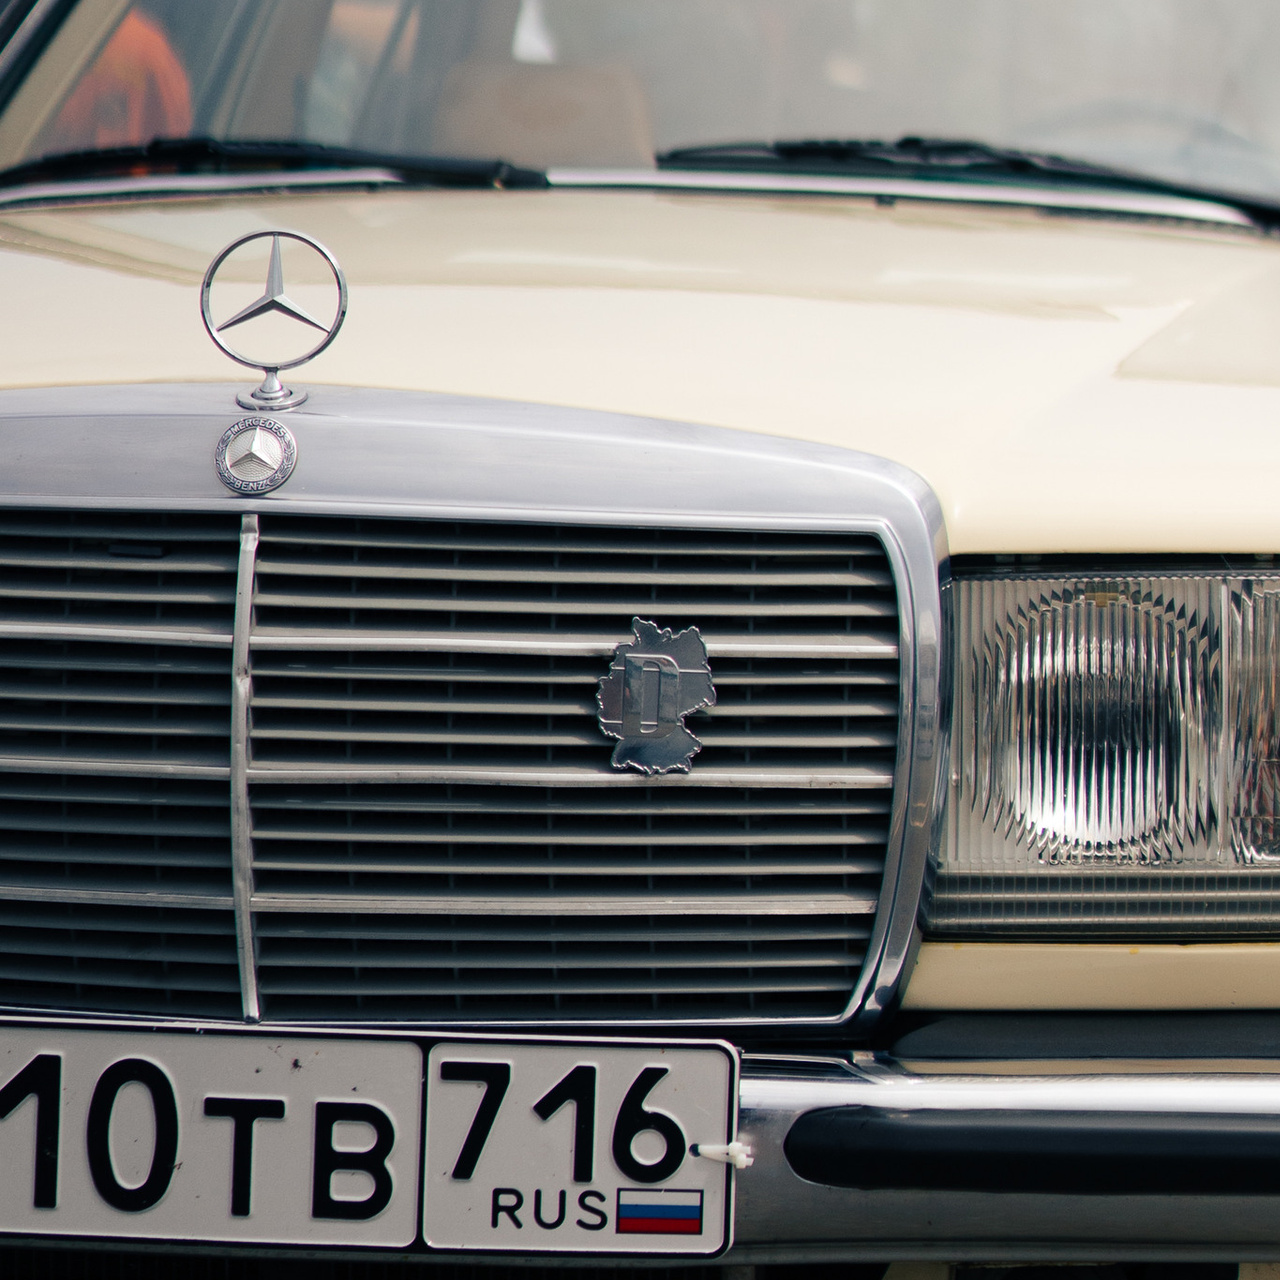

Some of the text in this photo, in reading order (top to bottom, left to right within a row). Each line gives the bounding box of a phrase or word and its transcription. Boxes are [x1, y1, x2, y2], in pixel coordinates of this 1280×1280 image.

[231, 418, 286, 437] MERCEDES
[234, 480, 265, 491] BENZ
[623, 653, 680, 738] D
[440, 1061, 687, 1184] 716
[491, 1187, 609, 1230] RUS
